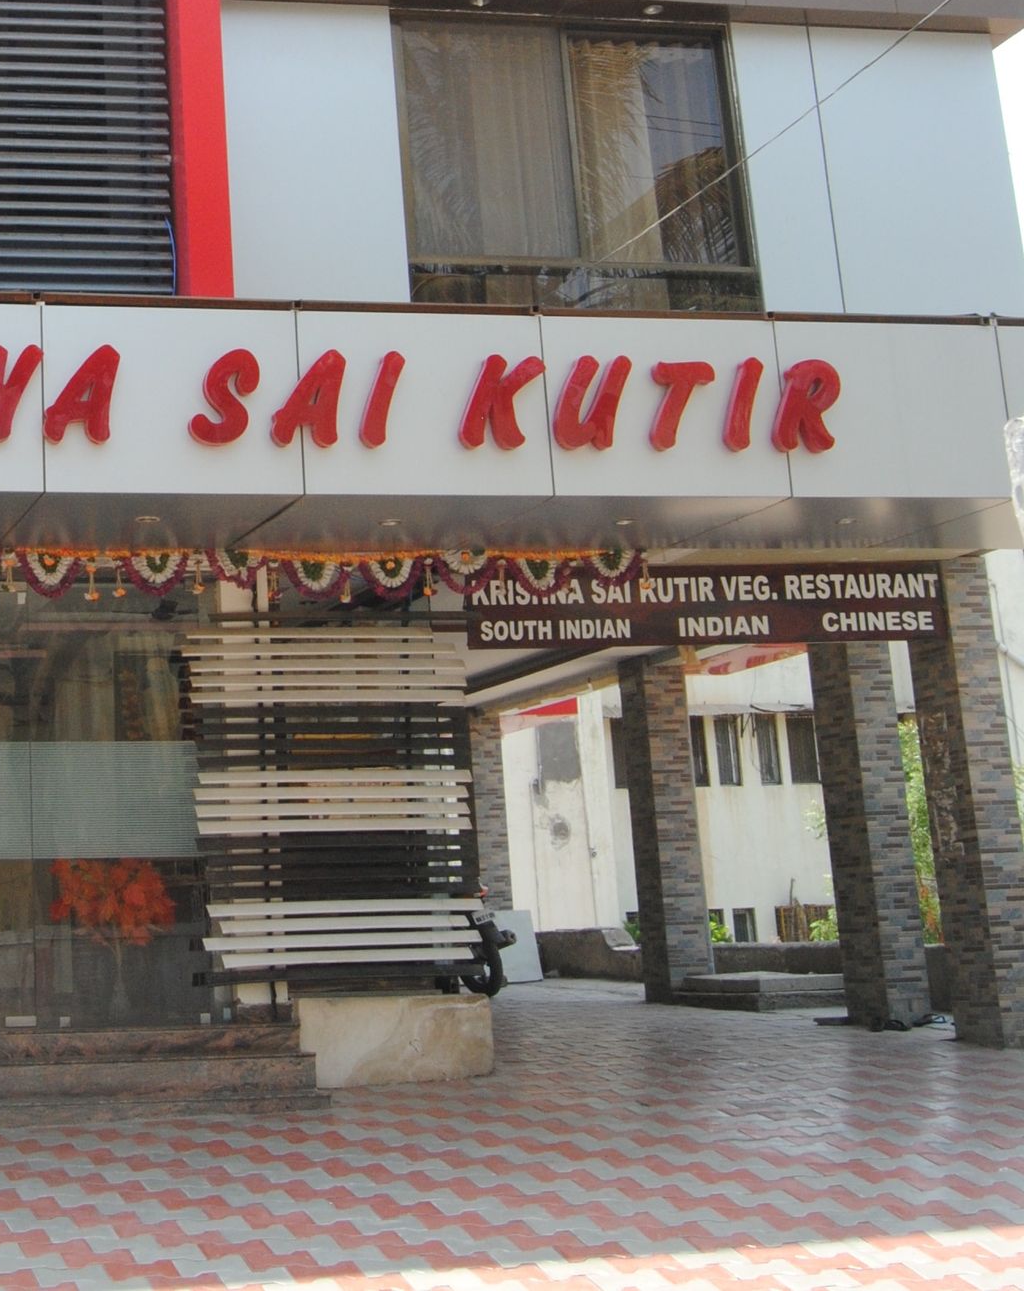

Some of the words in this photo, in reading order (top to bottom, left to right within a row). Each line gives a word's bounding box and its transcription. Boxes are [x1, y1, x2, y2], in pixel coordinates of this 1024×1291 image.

[188, 348, 405, 449] SAI
[458, 354, 841, 454] KUTIR
[591, 579, 631, 604] SAI
[639, 576, 715, 603] KUTIR
[720, 576, 778, 601] VEG.
[784, 574, 938, 600] RESTAURANT
[480, 620, 552, 641] SOUTH
[559, 619, 631, 640] INDIAN
[678, 616, 770, 637] INDIAN
[822, 611, 934, 632] CHINESE
